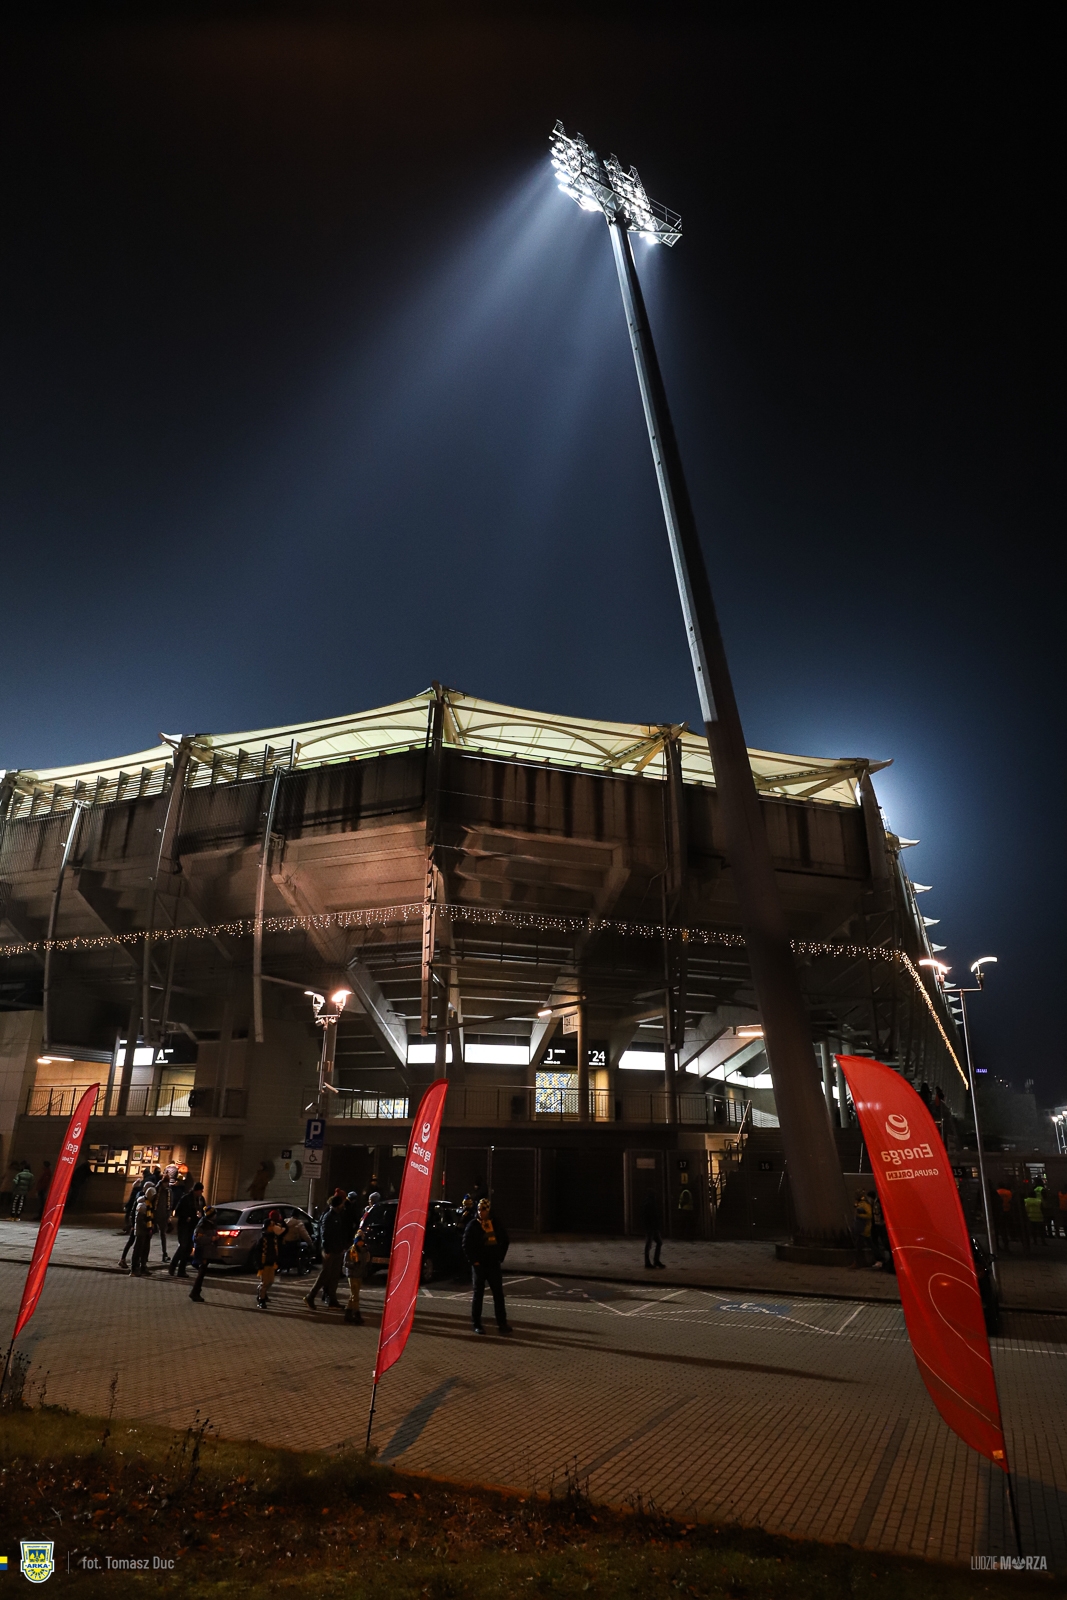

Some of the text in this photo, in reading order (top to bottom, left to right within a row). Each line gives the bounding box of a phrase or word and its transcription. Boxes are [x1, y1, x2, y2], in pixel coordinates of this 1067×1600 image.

[156, 1048, 164, 1060] A
[546, 1048, 553, 1060] J
[592, 1050, 606, 1062] 24
[309, 1121, 322, 1140] P
